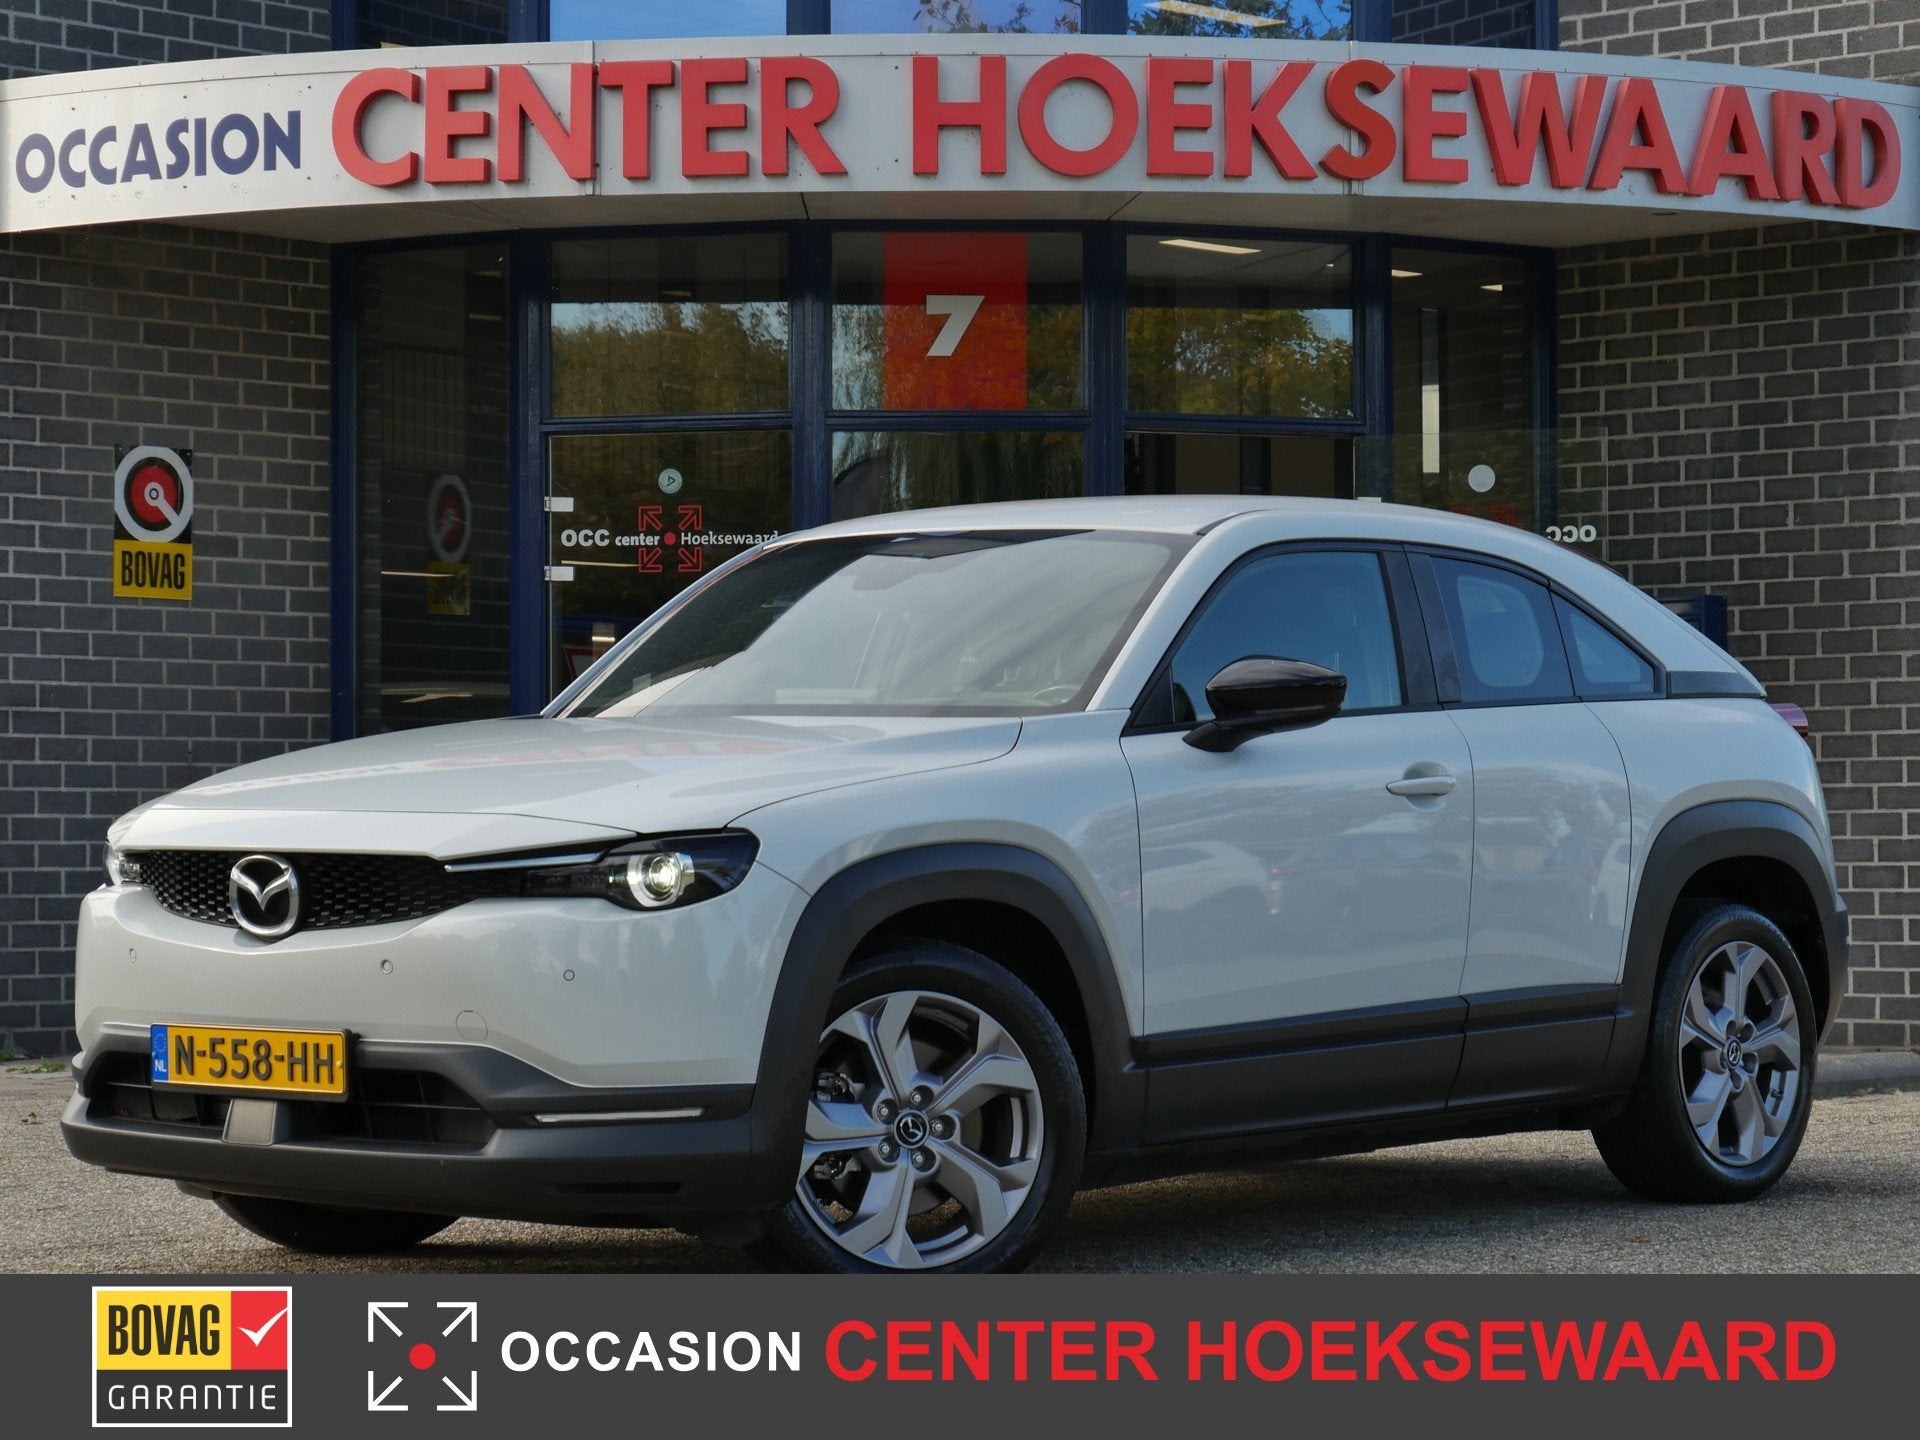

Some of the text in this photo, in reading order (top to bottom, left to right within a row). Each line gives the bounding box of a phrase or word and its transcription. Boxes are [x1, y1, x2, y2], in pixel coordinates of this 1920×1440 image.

[15, 53, 1900, 209] OCCASION CENTER HOEKSEWAARD
[926, 294, 986, 356] 7
[561, 529, 610, 547] OCC
[615, 532, 660, 546] center
[121, 550, 185, 589] BOVAG
[155, 1059, 167, 1073] NL
[174, 1034, 334, 1084] N-558-HH
